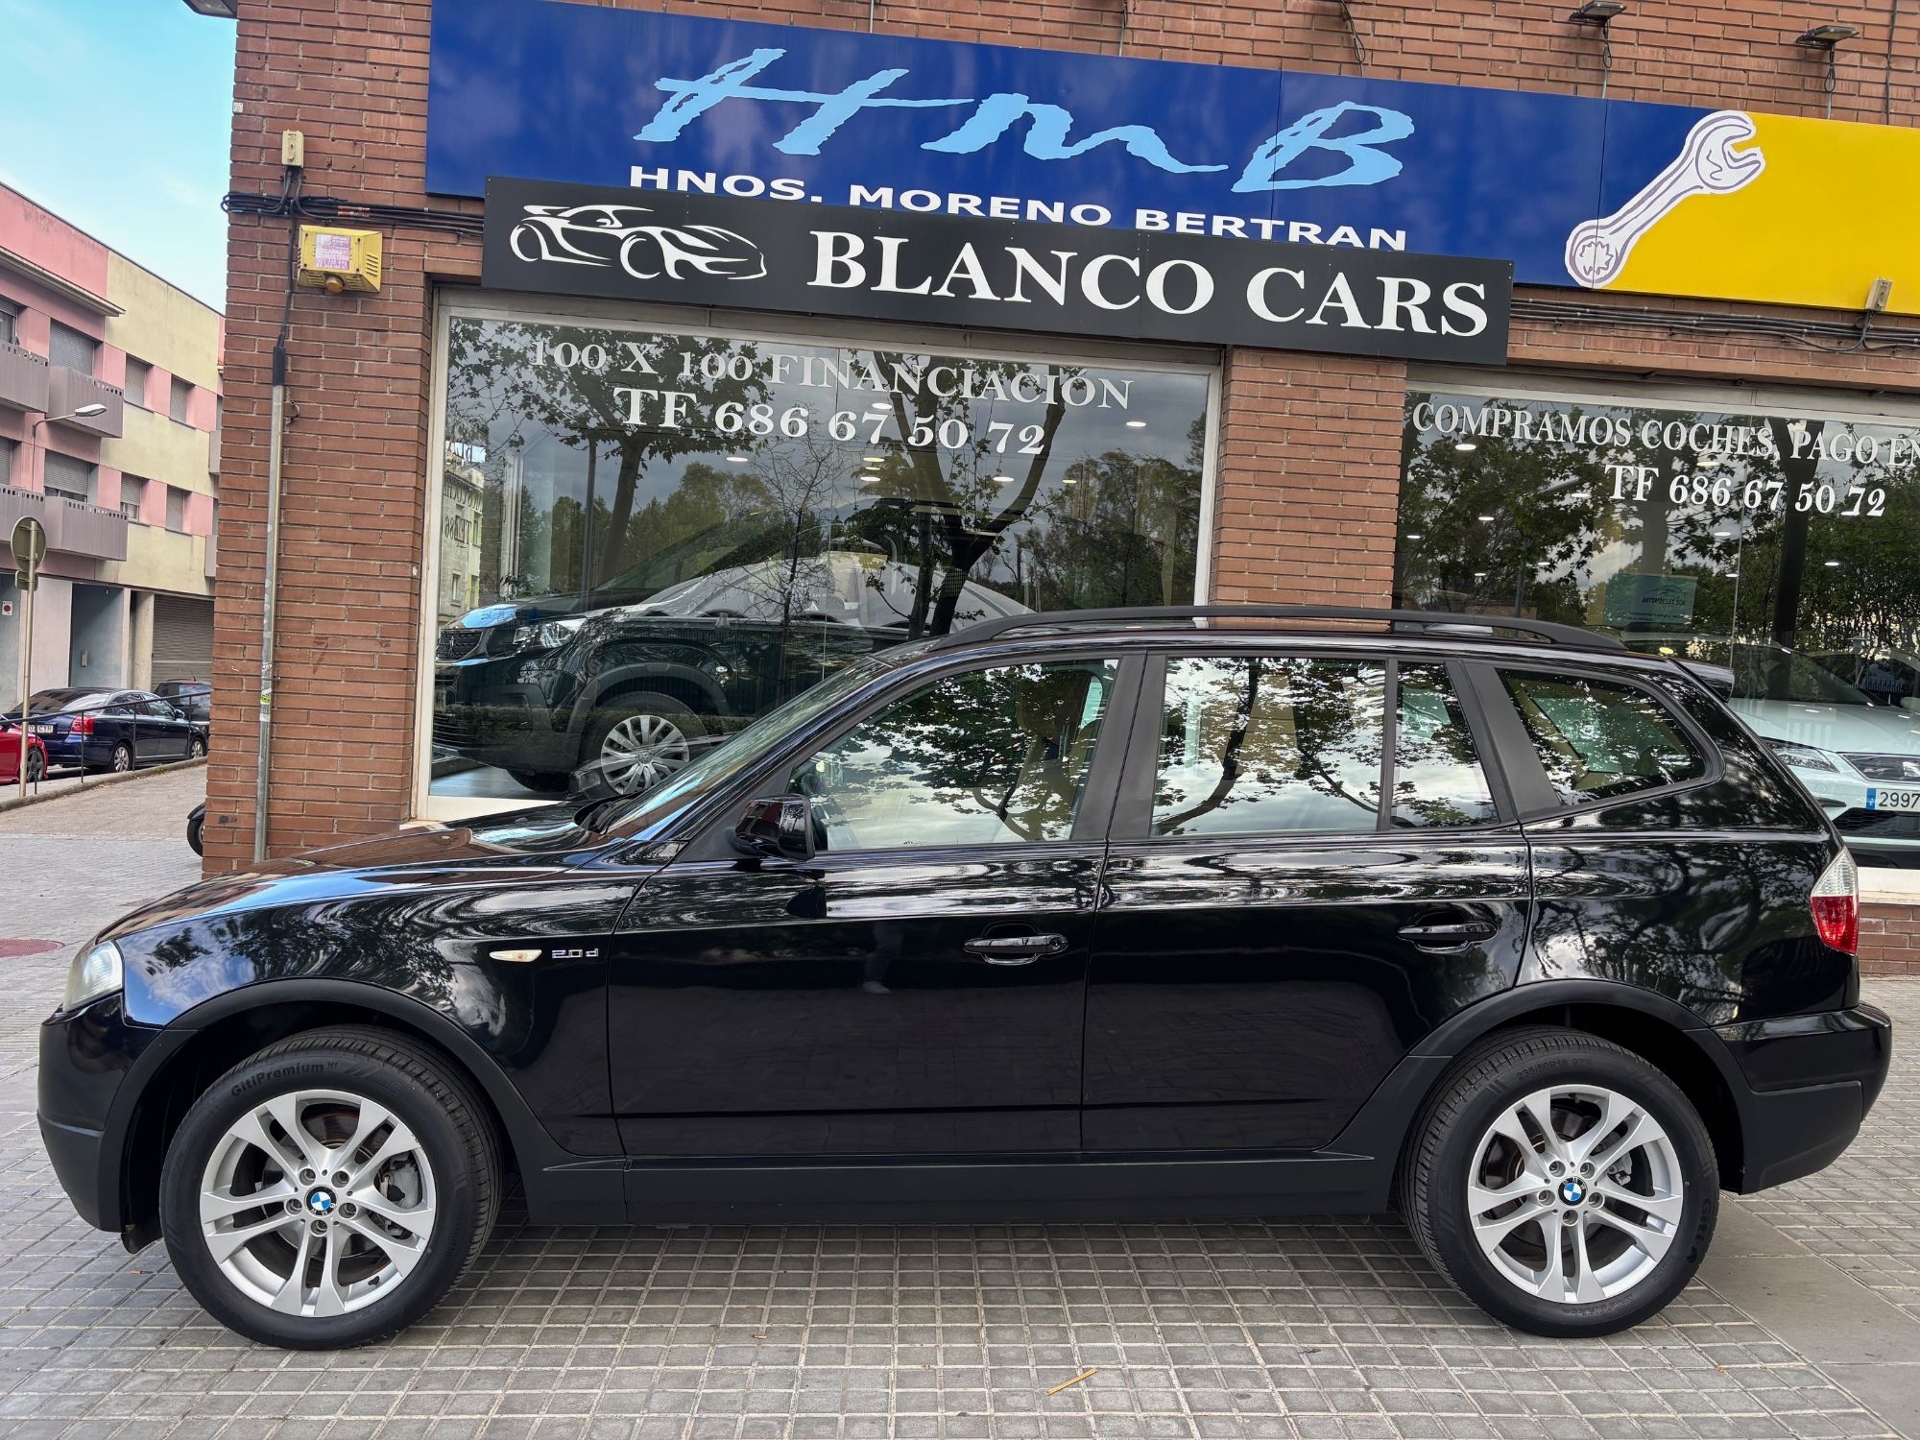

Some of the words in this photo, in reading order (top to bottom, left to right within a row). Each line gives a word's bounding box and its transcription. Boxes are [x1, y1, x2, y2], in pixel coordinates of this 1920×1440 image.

[630, 165, 823, 203] HNOS.
[849, 184, 1112, 227] MORENO
[1135, 208, 1406, 251] BERTRAN
[807, 230, 1215, 315] BLANCO
[1246, 267, 1488, 337] CARS
[530, 341, 607, 370] 100
[620, 342, 659, 374] X
[678, 351, 753, 381] 100
[767, 353, 1134, 410] FINANCIACIÓN
[613, 387, 698, 428] TF
[714, 402, 809, 438] 686
[828, 411, 889, 444] 67
[907, 415, 970, 449] 50
[988, 420, 1045, 455] 72
[1412, 402, 1631, 448] COMPRAMOS
[1790, 430, 1879, 465] PAGO
[1604, 464, 1659, 501] TF
[1669, 474, 1732, 507] 686
[1744, 479, 1785, 511] 67
[1794, 481, 1836, 514] 50
[1847, 485, 1886, 517] 72
[1878, 791, 1920, 809] 2997
[231, 1061, 324, 1097] GitiPremium
